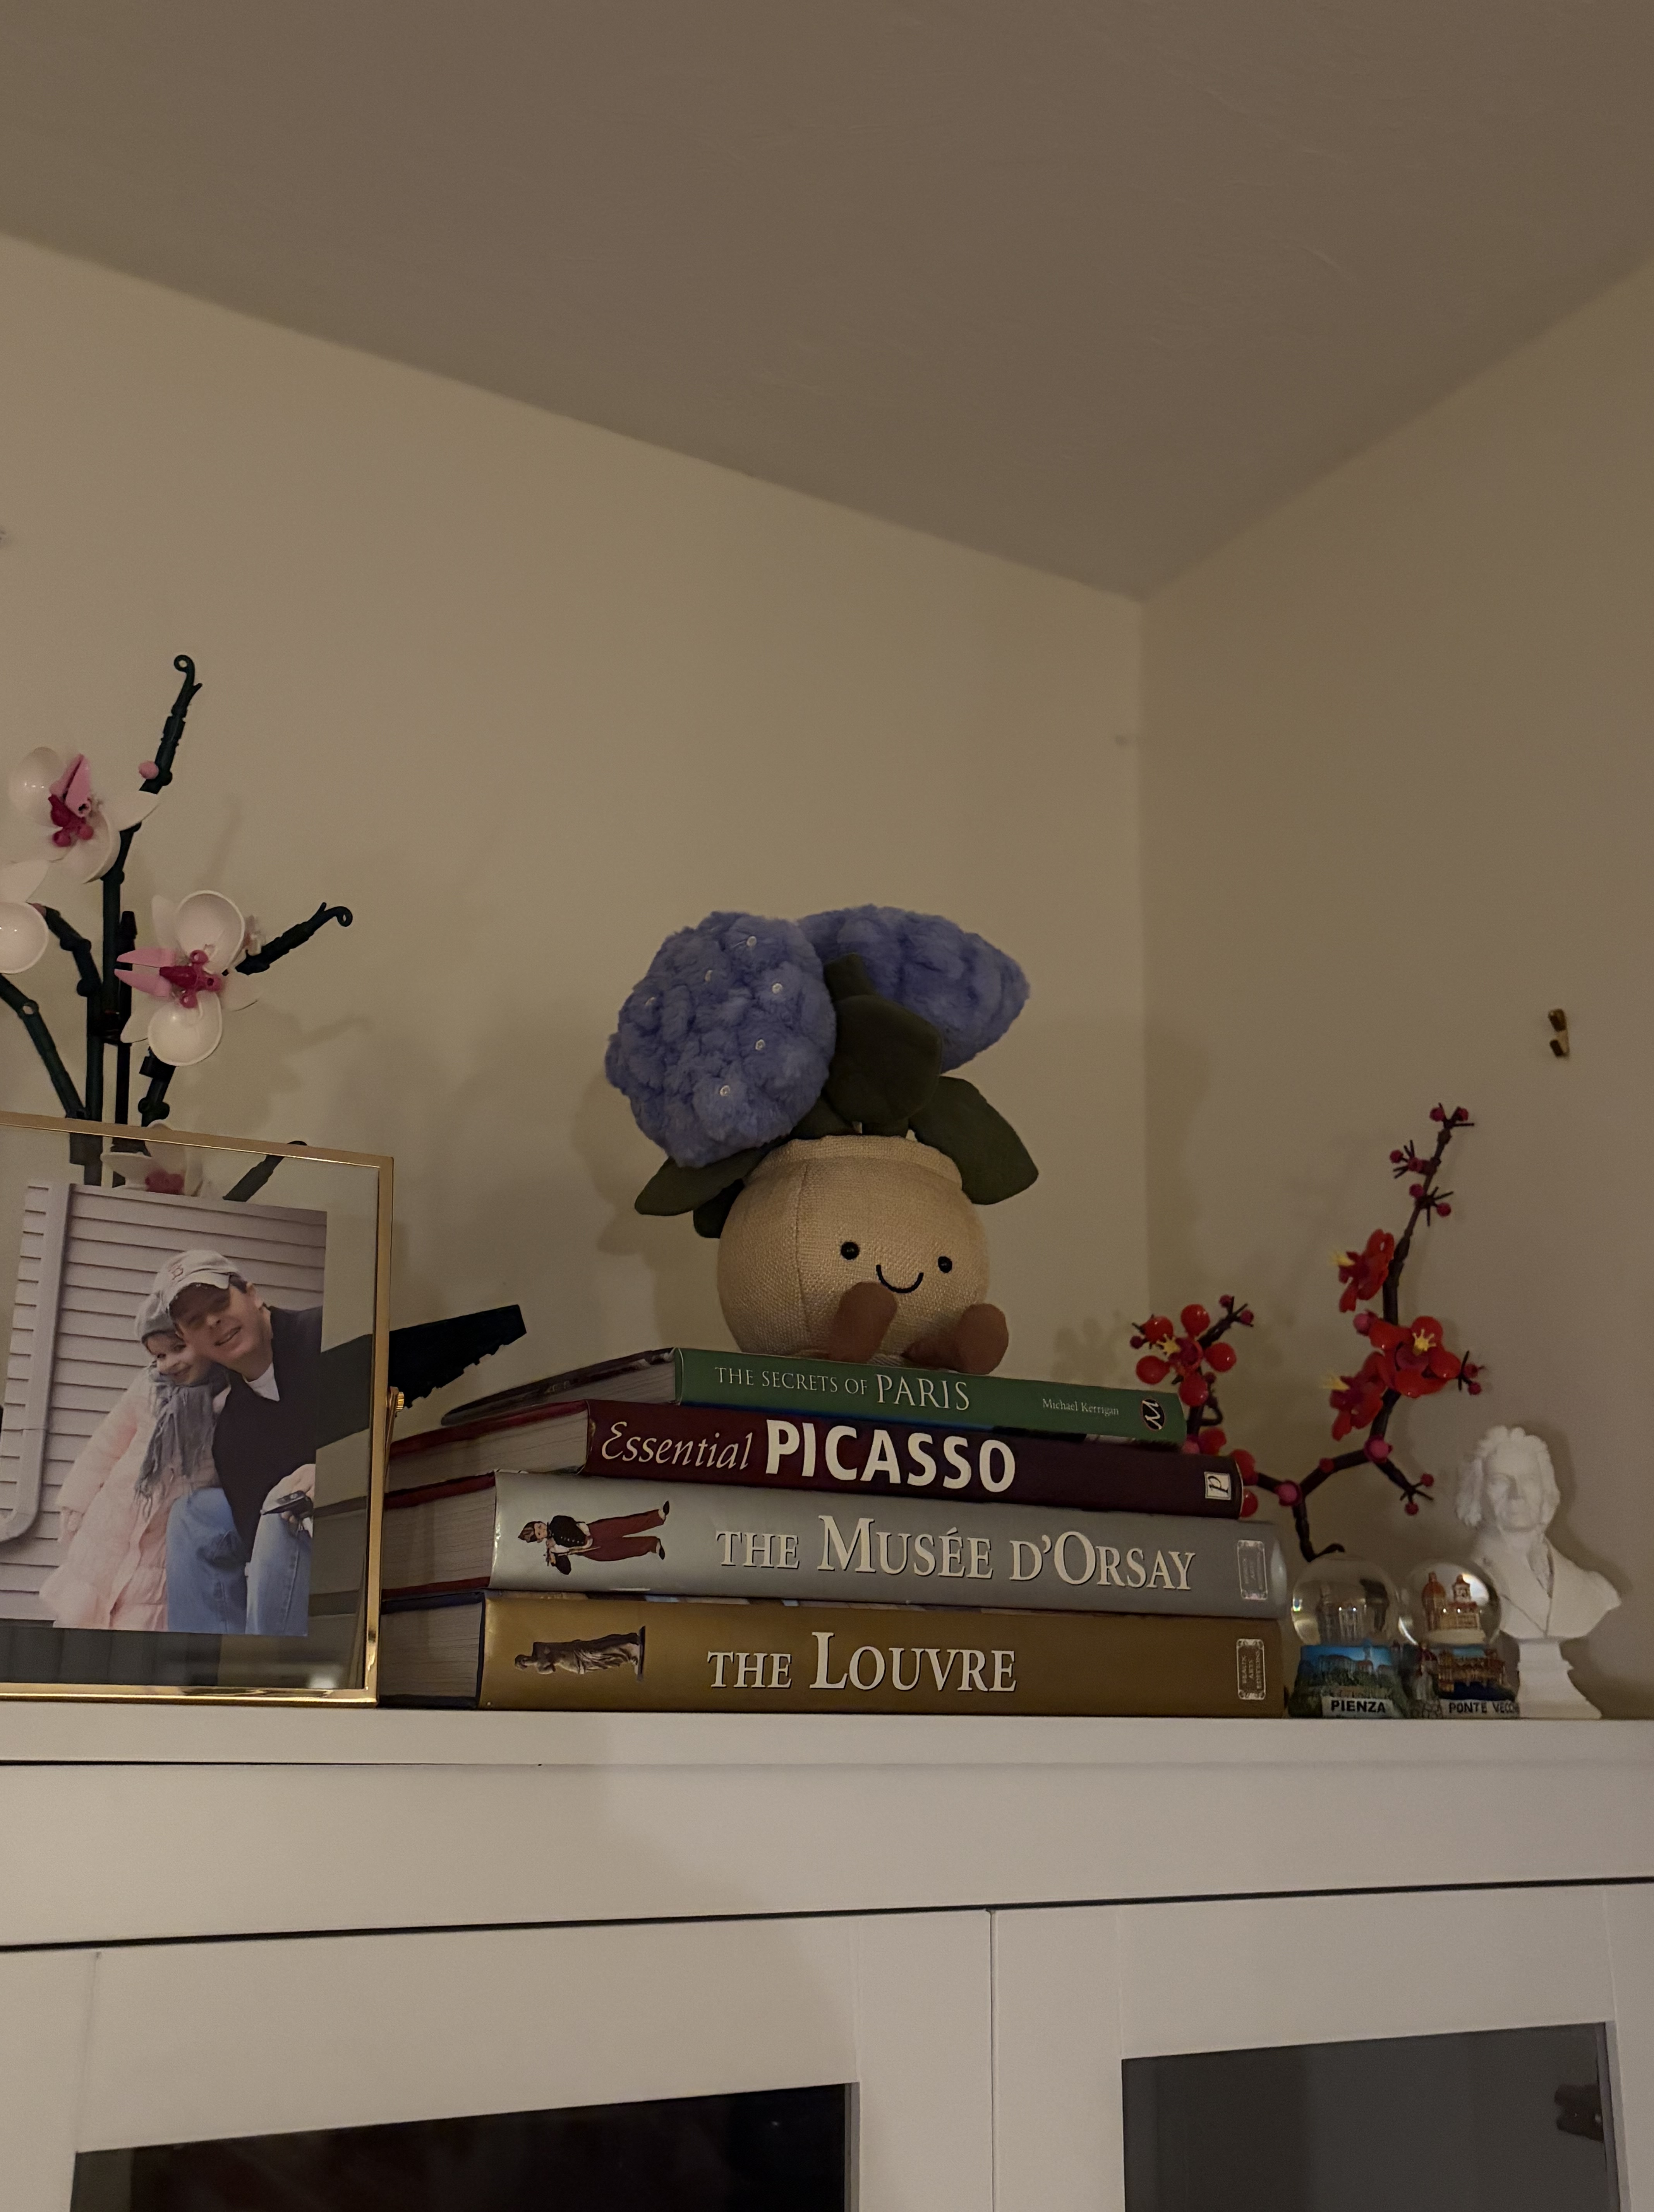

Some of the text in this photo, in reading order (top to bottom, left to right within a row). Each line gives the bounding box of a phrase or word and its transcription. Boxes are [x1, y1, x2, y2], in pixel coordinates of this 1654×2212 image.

[715, 1367, 969, 1411] THE SECRETS OF PARIS
[1043, 1398, 1119, 1417] Michael Kerrigan
[601, 1419, 1016, 1493] Essential PICASSO
[715, 1530, 800, 1569] THE
[817, 1515, 993, 1579] MUSÉE
[1009, 1531, 1196, 1590] D'ORSAY
[707, 1632, 1017, 1692] THE LOUVRE
[1331, 1700, 1386, 1713] PIENZA
[1449, 1702, 1487, 1713] PONTE
